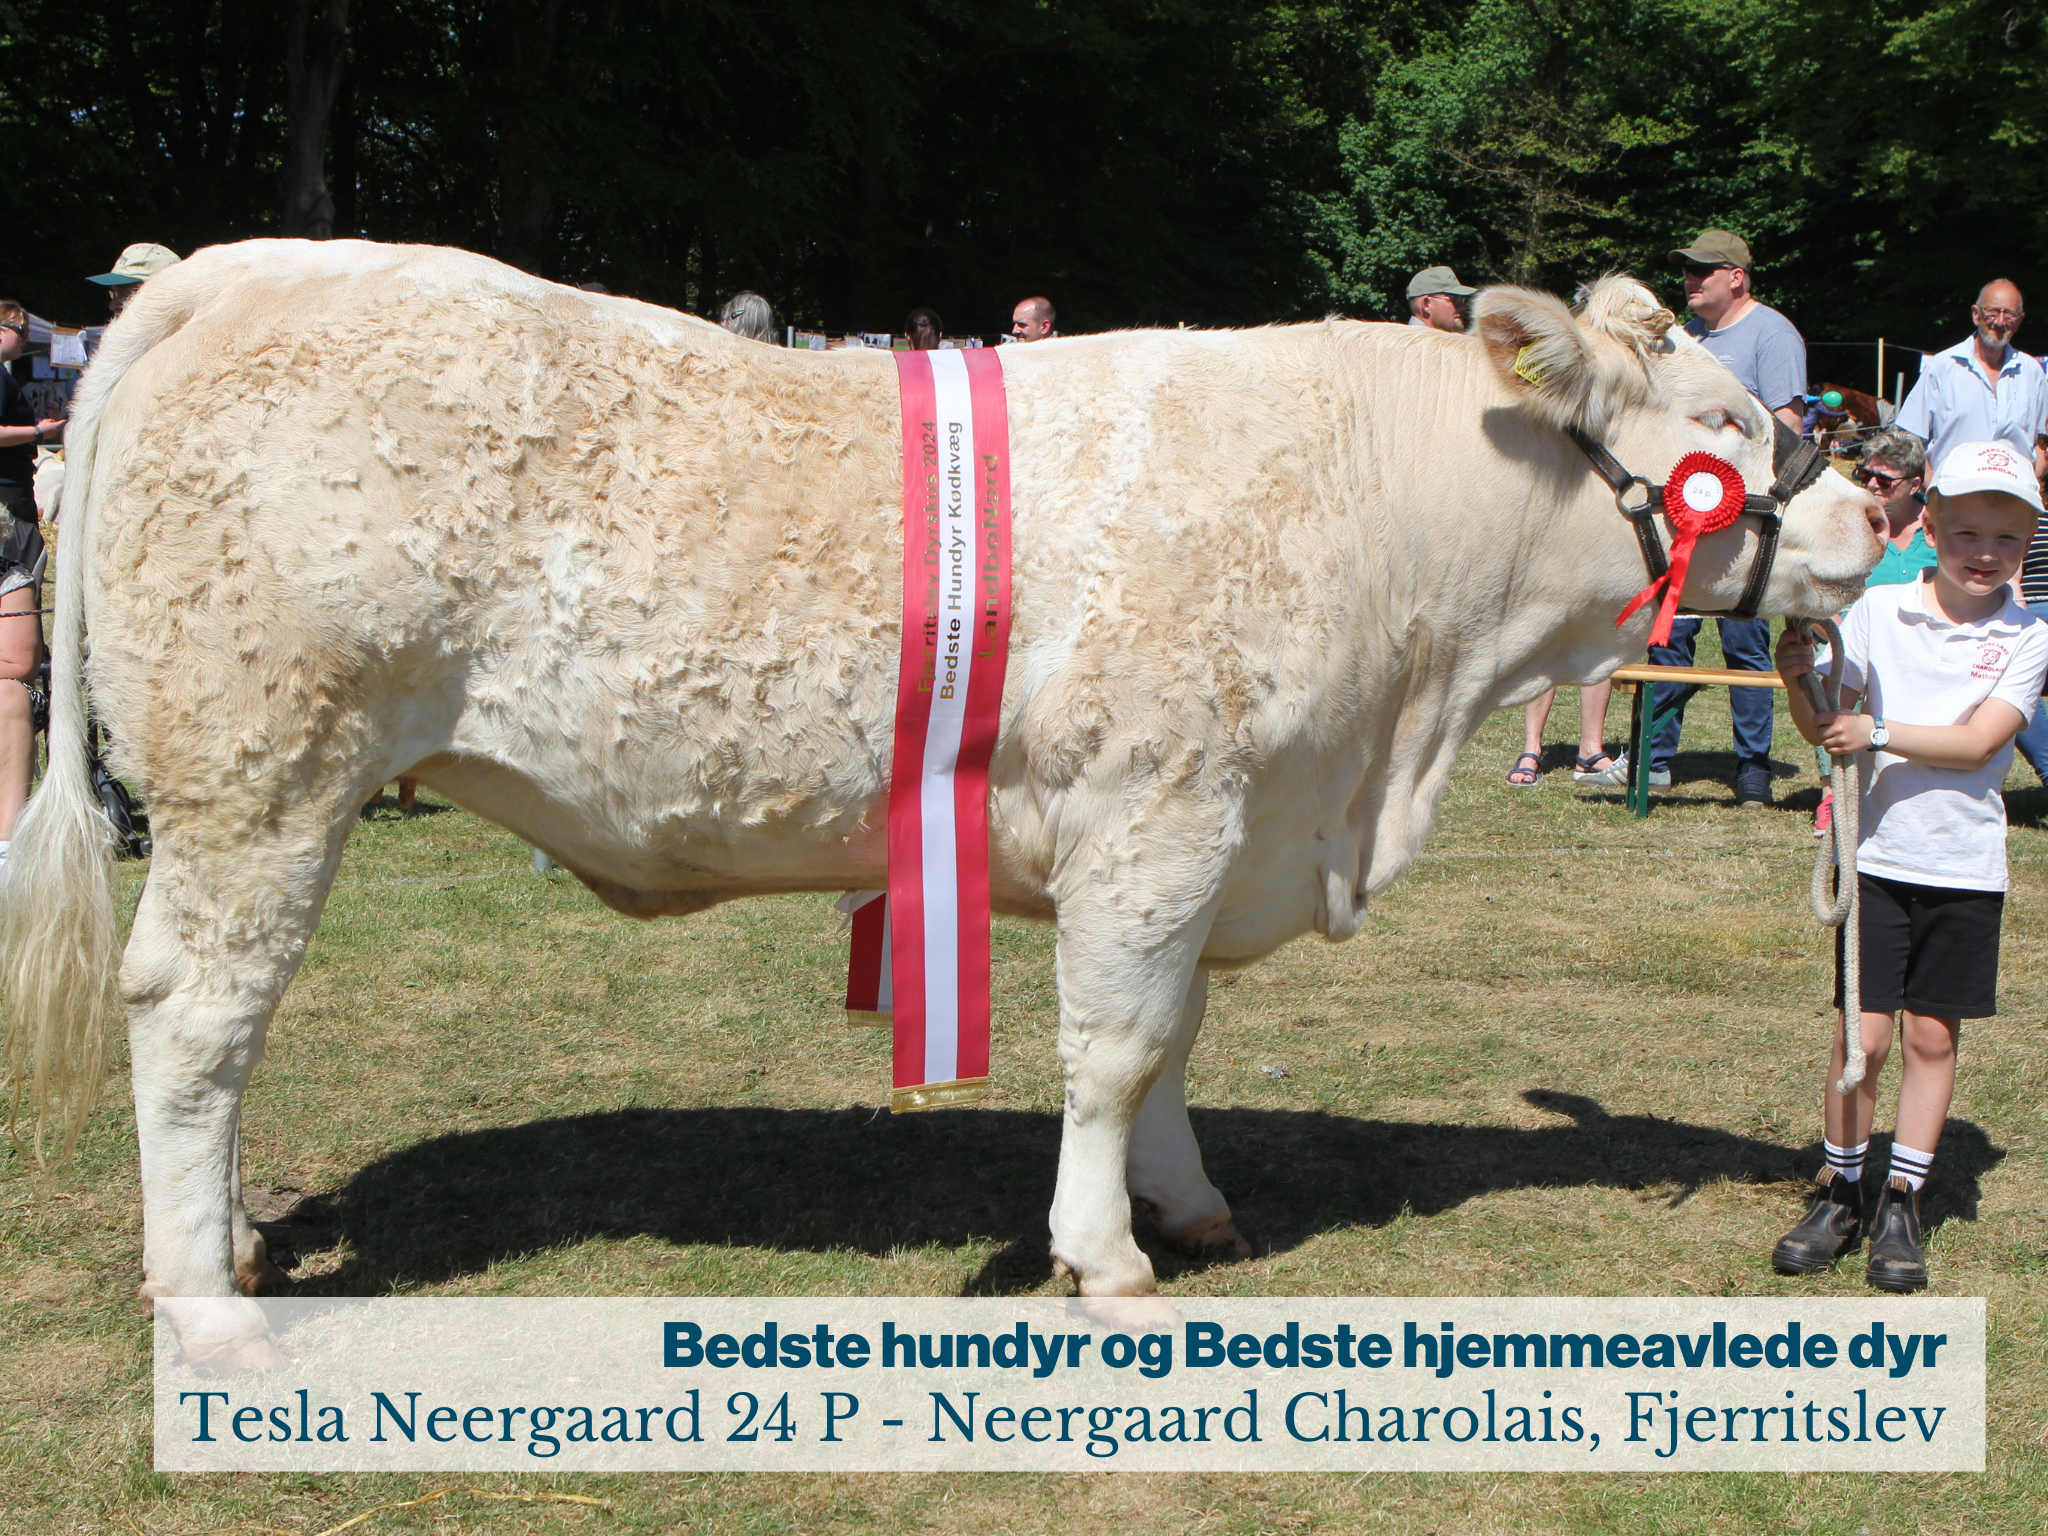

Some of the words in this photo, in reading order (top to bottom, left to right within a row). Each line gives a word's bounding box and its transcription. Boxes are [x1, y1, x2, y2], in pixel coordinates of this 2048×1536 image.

[922, 421, 937, 468] 2024
[947, 422, 963, 518] Kødkvæg
[924, 474, 942, 565] Dyrskue
[1692, 486, 1704, 495] 24
[1704, 490, 1713, 498] p.
[947, 525, 966, 610] Hundyr
[978, 455, 999, 658] LandboNord
[917, 573, 937, 692] Fjerritslev
[940, 618, 961, 699] Bedste
